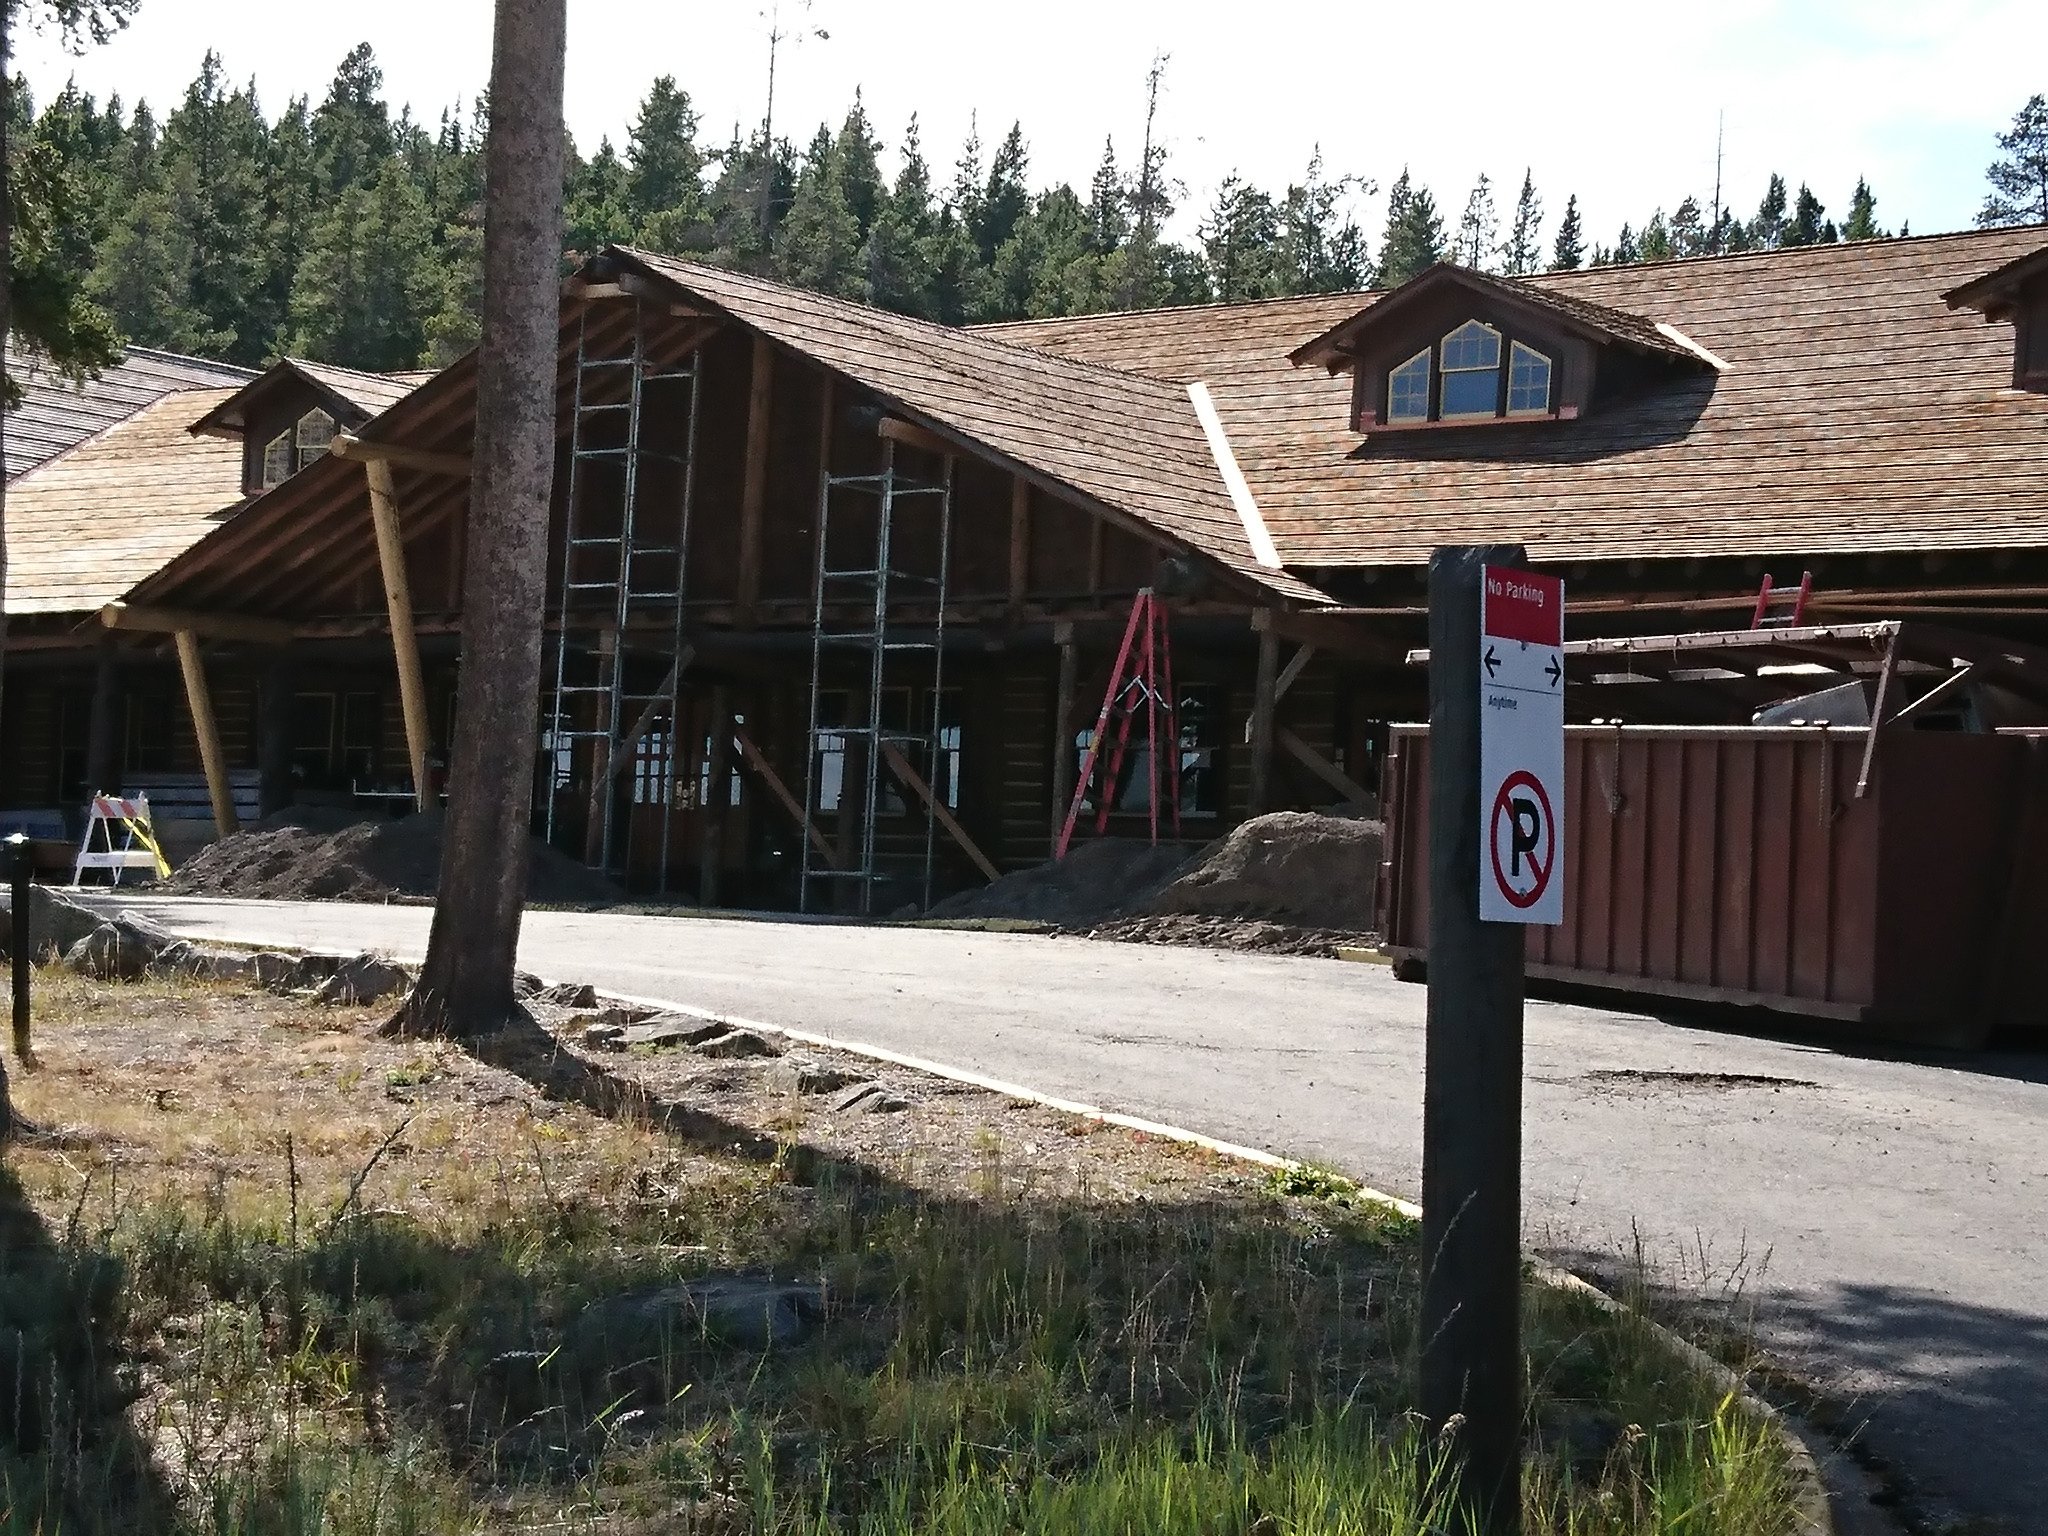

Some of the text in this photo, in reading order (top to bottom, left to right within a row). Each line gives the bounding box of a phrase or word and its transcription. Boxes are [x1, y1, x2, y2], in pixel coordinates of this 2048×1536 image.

[1487, 578, 1544, 608] No Parking
[1488, 694, 1518, 710] Anytime
[1511, 797, 1541, 877] P
